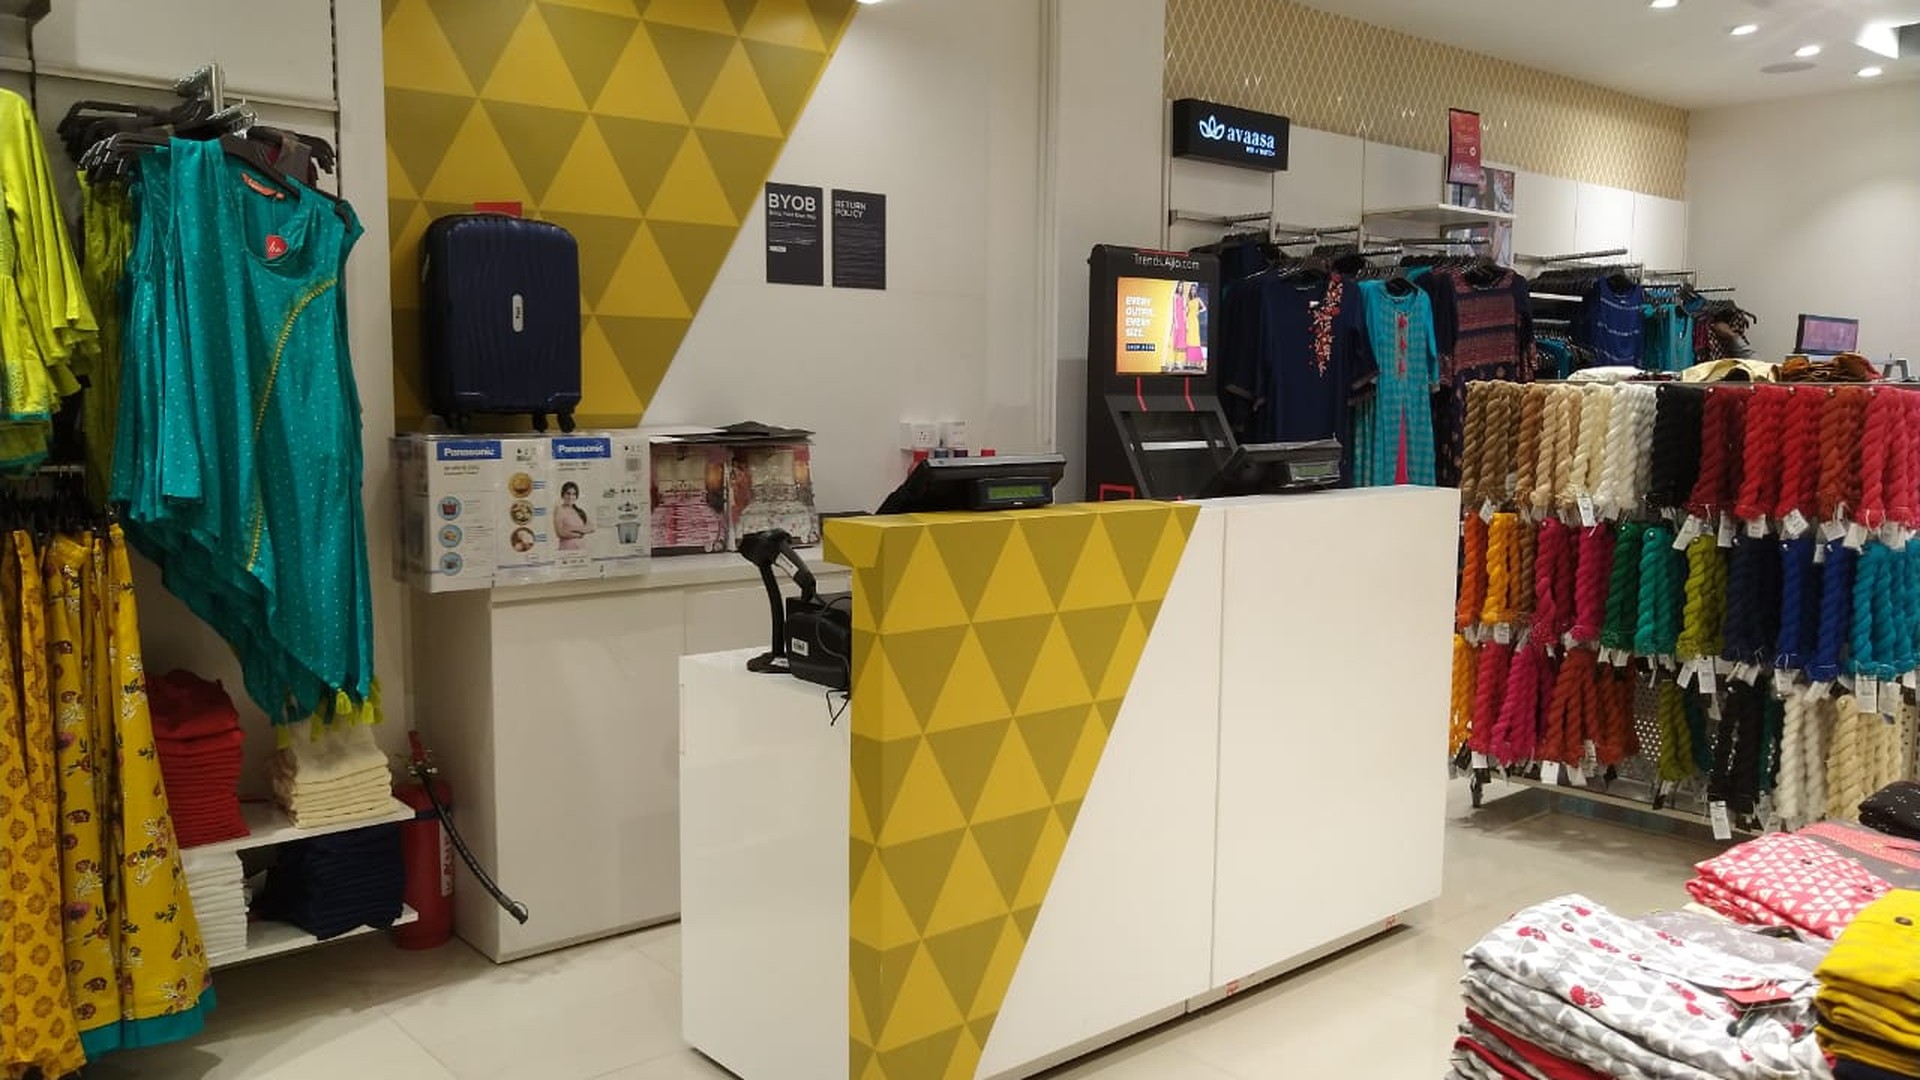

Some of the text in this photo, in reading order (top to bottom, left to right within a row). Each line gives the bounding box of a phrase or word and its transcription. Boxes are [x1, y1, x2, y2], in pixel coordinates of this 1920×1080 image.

[1227, 127, 1275, 149] avaasa
[768, 193, 816, 211] BYOB
[834, 200, 867, 211] RETURN
[834, 208, 864, 218] POLICY
[443, 445, 495, 457] Panasonic
[558, 442, 605, 454] Panasonic
